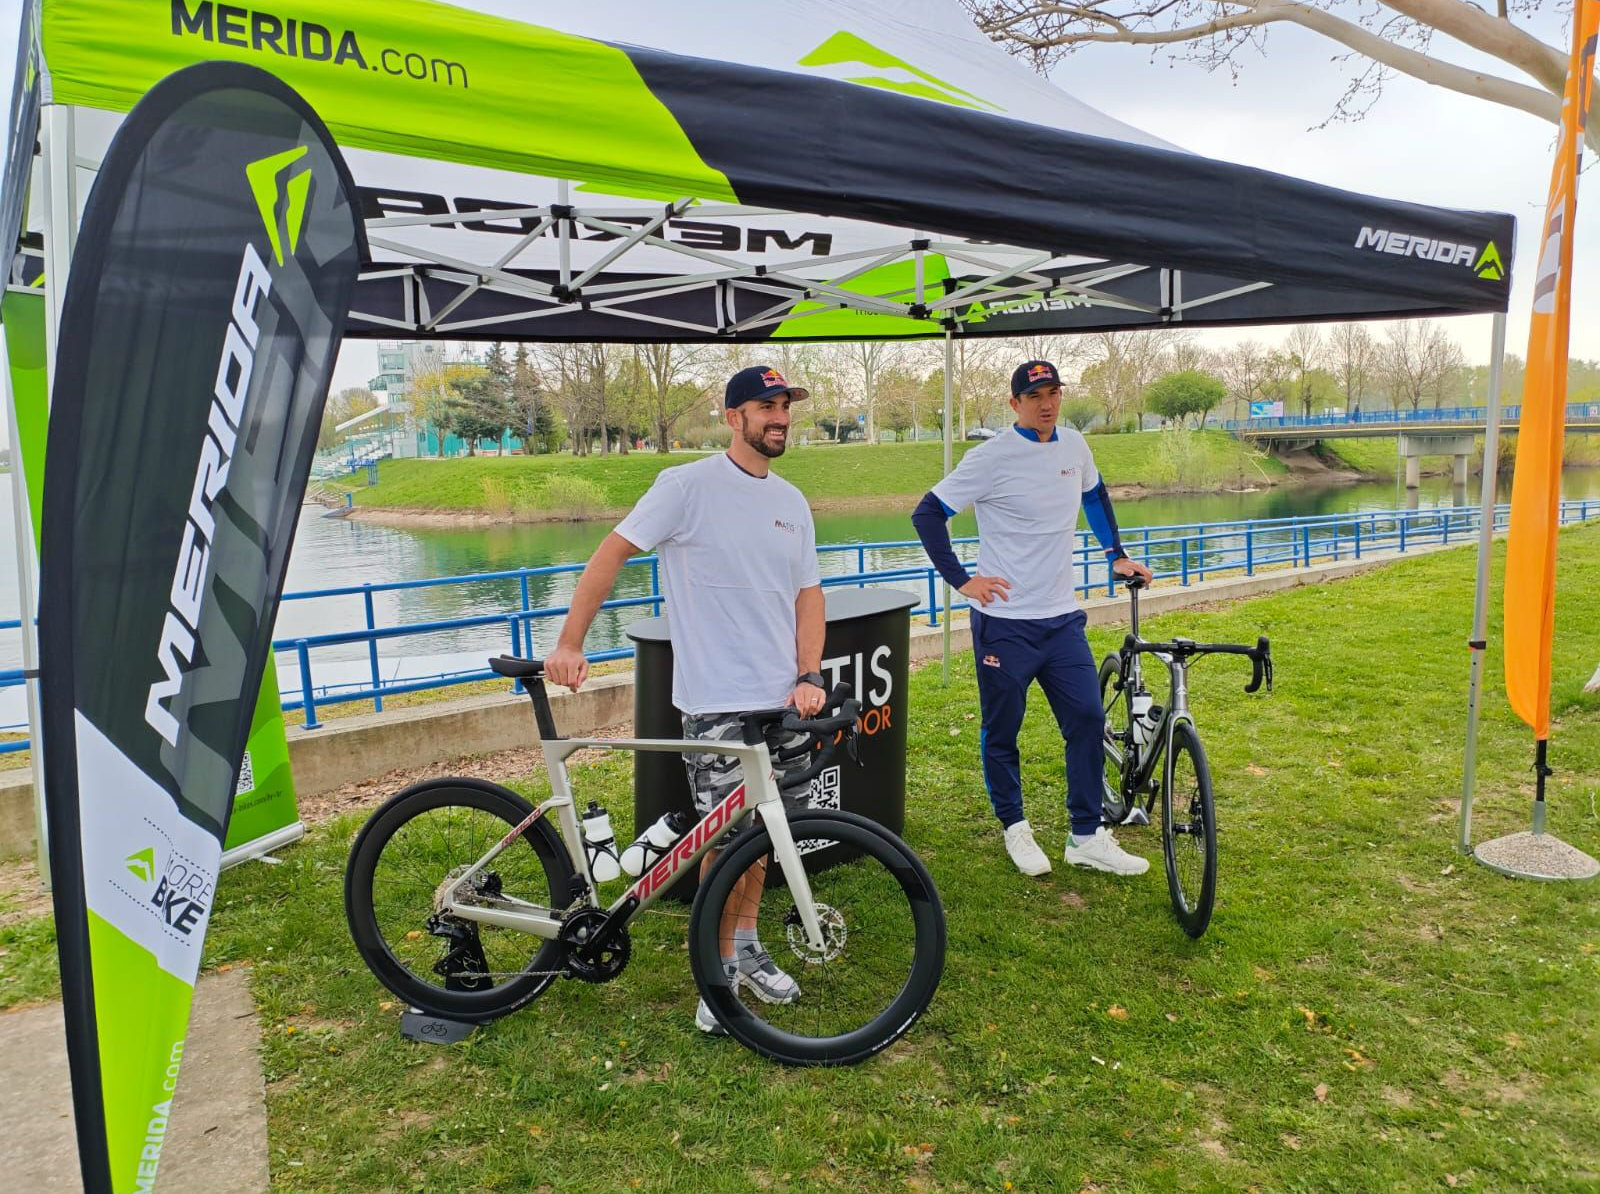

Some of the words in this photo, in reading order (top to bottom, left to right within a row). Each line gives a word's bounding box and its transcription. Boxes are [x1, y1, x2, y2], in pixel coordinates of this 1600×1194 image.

[170, 0, 469, 89] MERIDA.com
[1354, 226, 1478, 268] MERIDA
[144, 242, 273, 748] MERIDA
[820, 644, 893, 719] TIS
[625, 784, 746, 901] MERIDA
